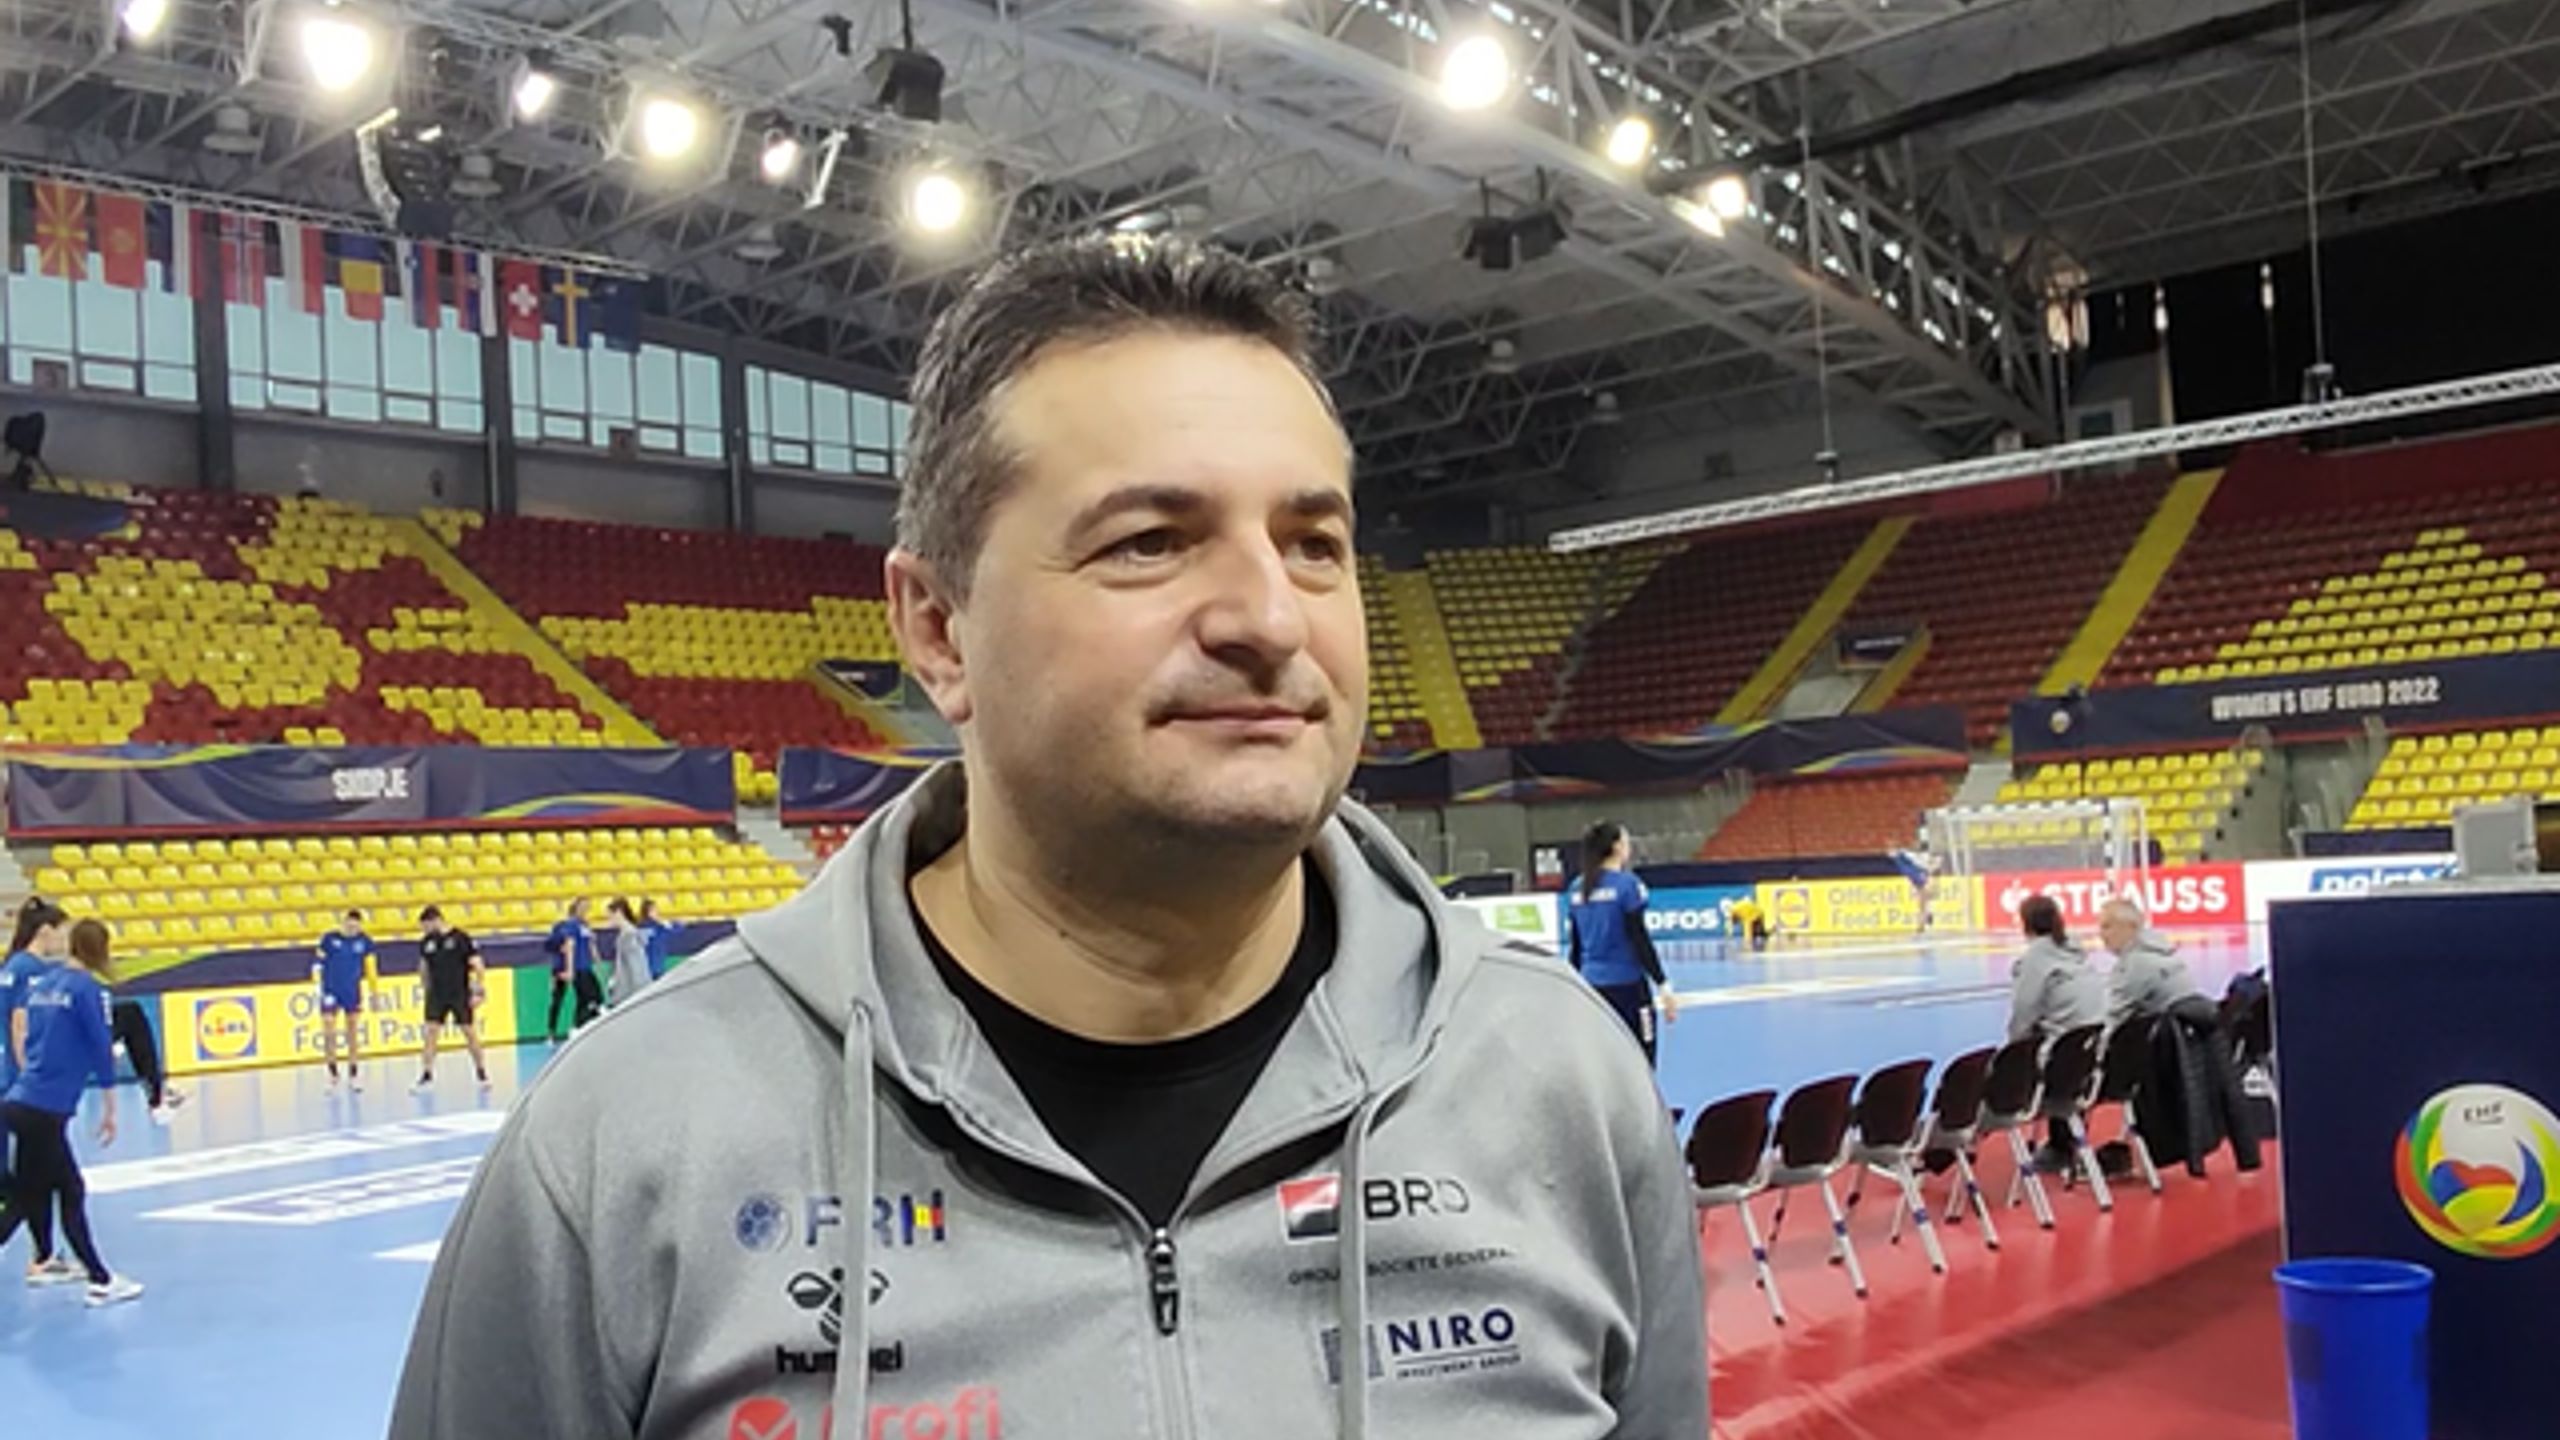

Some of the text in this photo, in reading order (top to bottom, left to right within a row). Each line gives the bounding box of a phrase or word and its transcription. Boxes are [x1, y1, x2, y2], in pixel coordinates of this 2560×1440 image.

[2212, 688, 2297, 721] WOMEN'S
[2336, 680, 2385, 710] EURO
[2387, 675, 2441, 705] 2022
[2041, 876, 2228, 916] STRAUSS
[2463, 1101, 2503, 1123] EHF
[1387, 1307, 1515, 1356] NIRO
